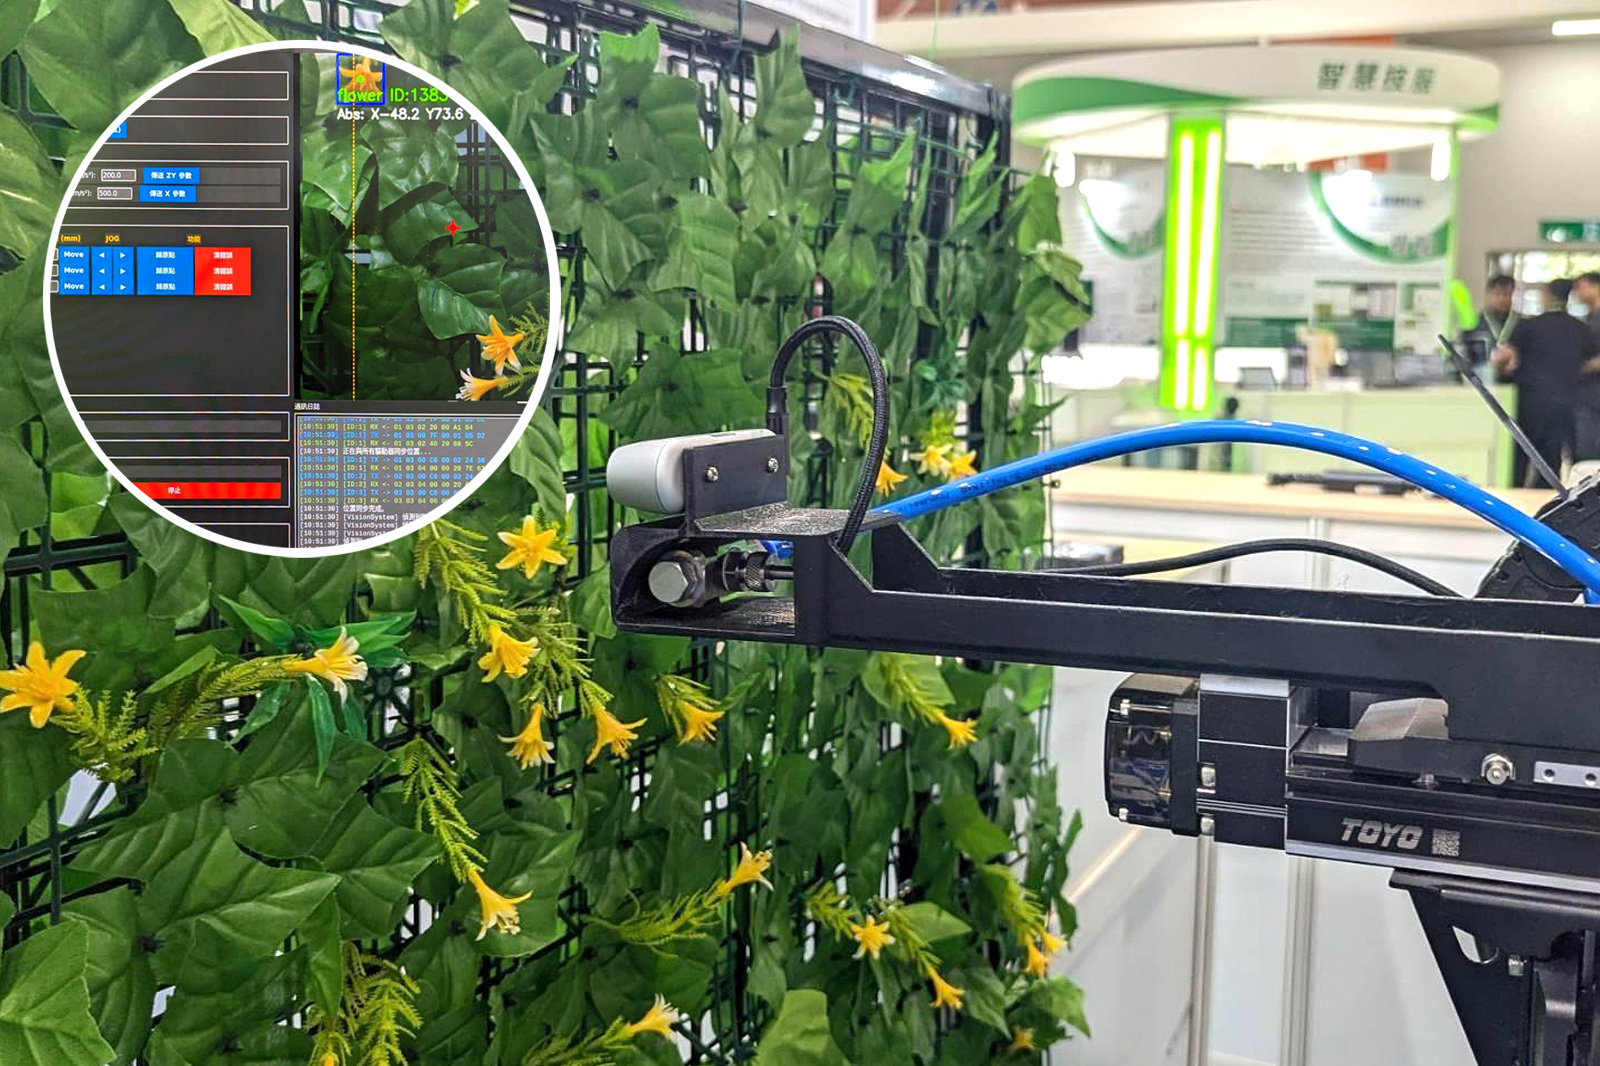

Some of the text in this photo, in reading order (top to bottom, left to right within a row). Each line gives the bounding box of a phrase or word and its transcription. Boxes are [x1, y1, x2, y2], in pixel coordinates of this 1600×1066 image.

[338, 88, 384, 102] flower
[337, 108, 364, 120] Abs:
[371, 108, 420, 120] X-48.2
[426, 108, 464, 120] Y73.6
[60, 234, 81, 242] (mm)
[105, 235, 120, 243] JOG
[1341, 817, 1424, 850] TOYO
